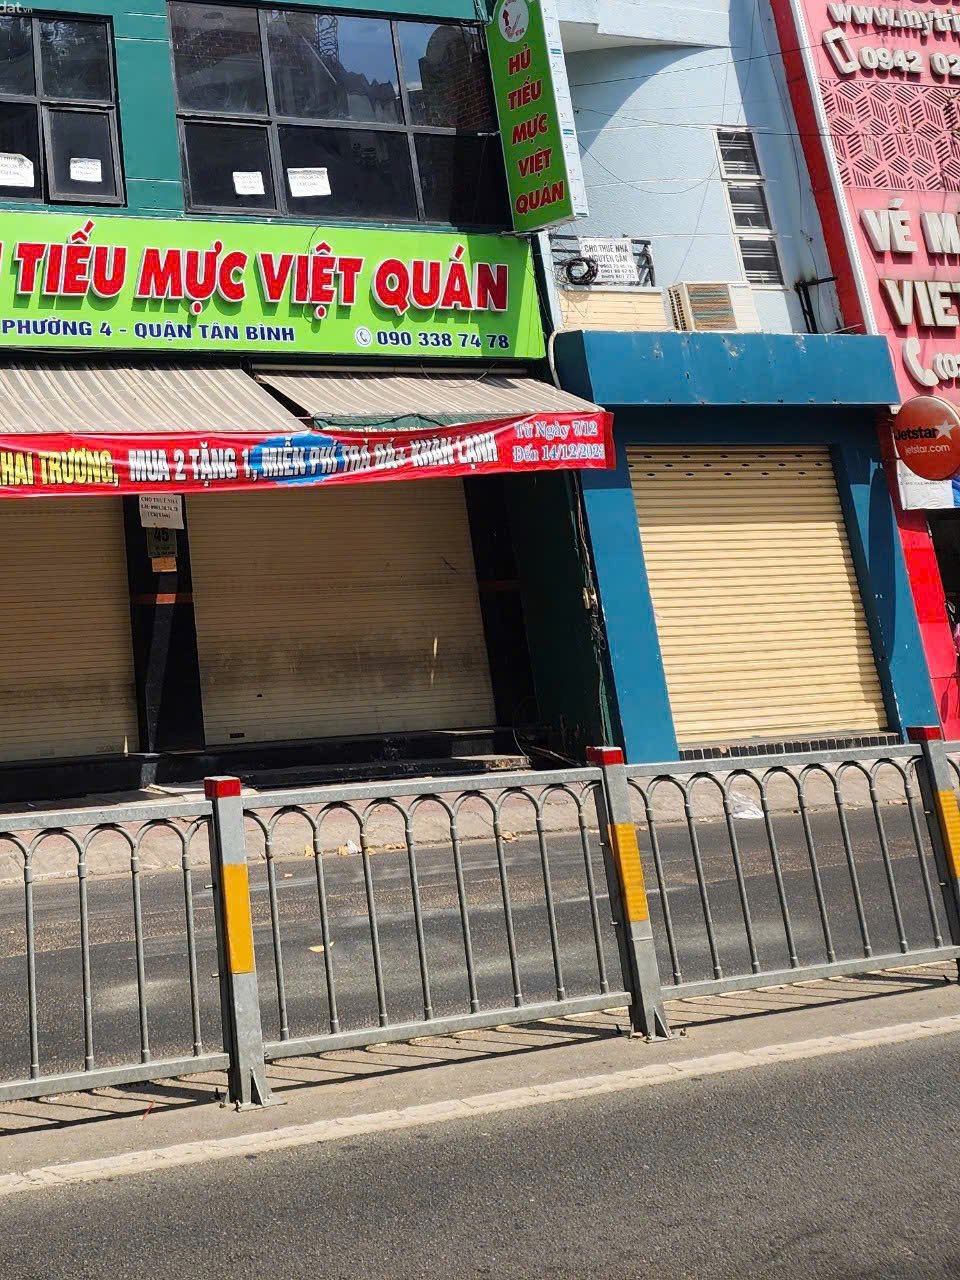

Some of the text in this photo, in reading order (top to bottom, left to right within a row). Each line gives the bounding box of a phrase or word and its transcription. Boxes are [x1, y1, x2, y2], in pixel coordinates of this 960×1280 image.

[508, 42, 531, 76] HỦ
[858, 47, 925, 75] 0942
[507, 75, 542, 111] TIẾU
[512, 112, 548, 146] MỰC
[518, 147, 552, 177] VIỆT
[515, 180, 565, 215] QUÁN
[860, 198, 918, 254] VÉ
[15, 219, 128, 298] TIẾU
[135, 240, 248, 315] MỰC
[256, 240, 365, 319] VIỆT
[372, 243, 509, 316] QUÁN
[880, 279, 960, 327] VIE
[2, 316, 92, 336] PHƯỜNG
[99, 322, 113, 337] 4
[134, 320, 192, 342] QUẬN
[198, 321, 239, 340] TÂN
[246, 323, 295, 341] BÌNH
[377, 331, 510, 349] 090 338 74 78
[514, 420, 598, 440] Từ Ngày 7/12
[128, 449, 171, 482] MUA
[173, 449, 186, 481] 2
[189, 442, 238, 487] TẶNG
[308, 439, 338, 475] PHÍ
[512, 443, 539, 462] Đến
[905, 443, 950, 456] jetstar.com
